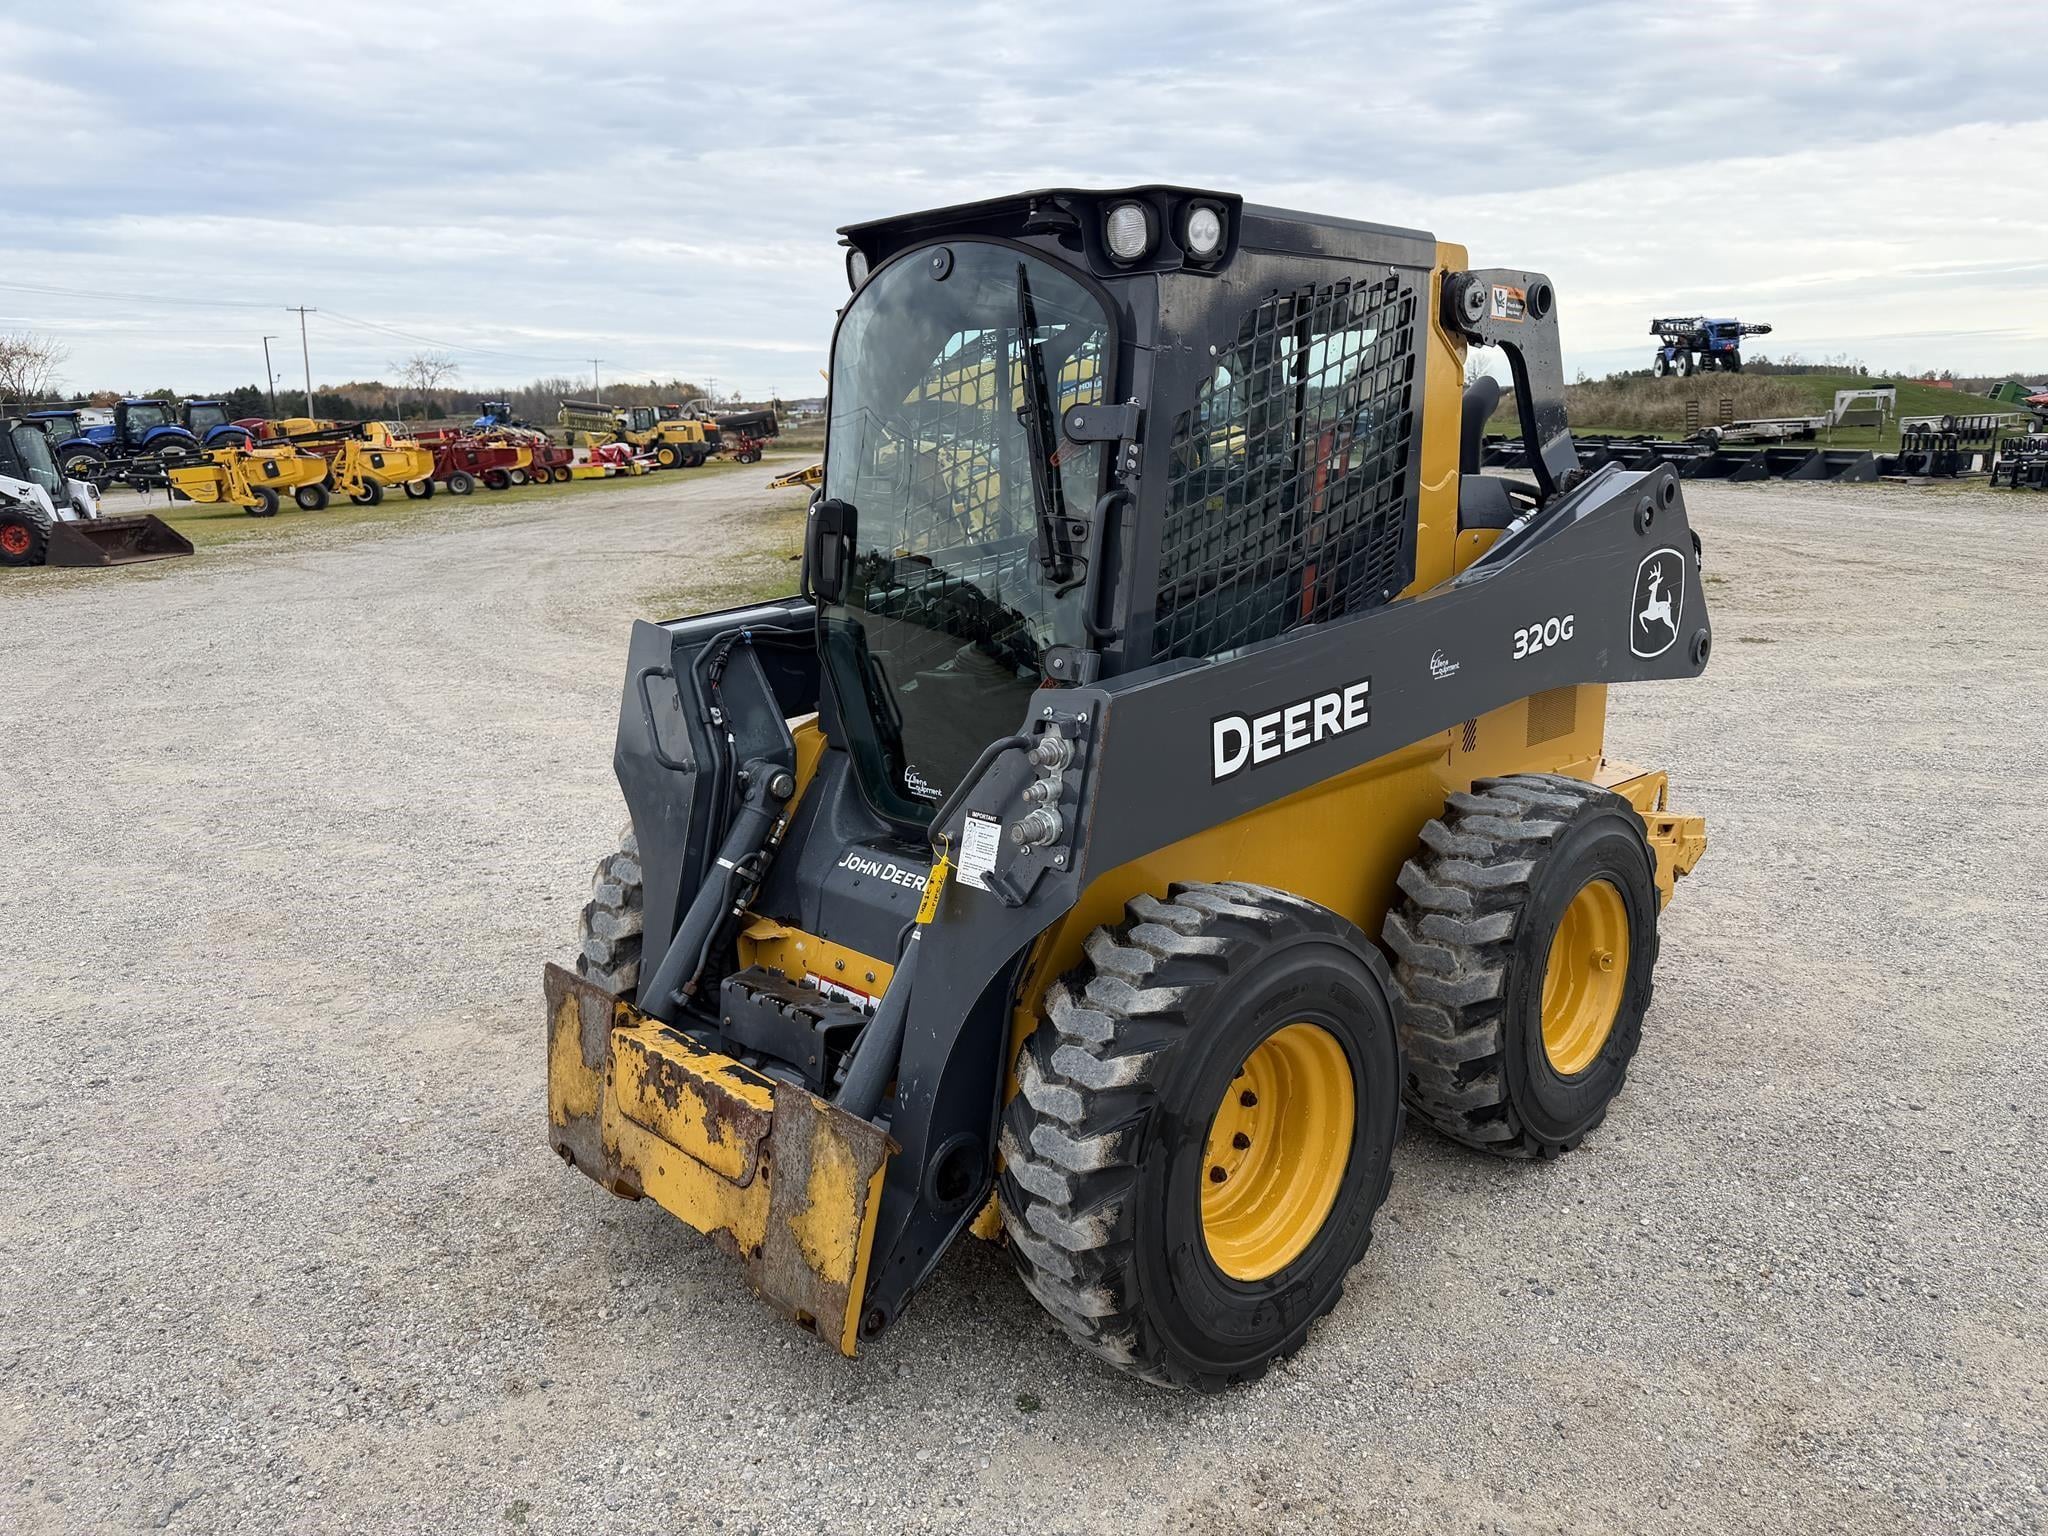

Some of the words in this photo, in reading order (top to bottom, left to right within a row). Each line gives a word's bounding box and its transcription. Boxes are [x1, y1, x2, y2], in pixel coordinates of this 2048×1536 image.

[1513, 614, 1574, 660] 320G
[1213, 681, 1369, 779] DEERE
[971, 811, 998, 823] IMPORTANT
[838, 852, 882, 877] JOHN
[880, 863, 929, 892] DEER
